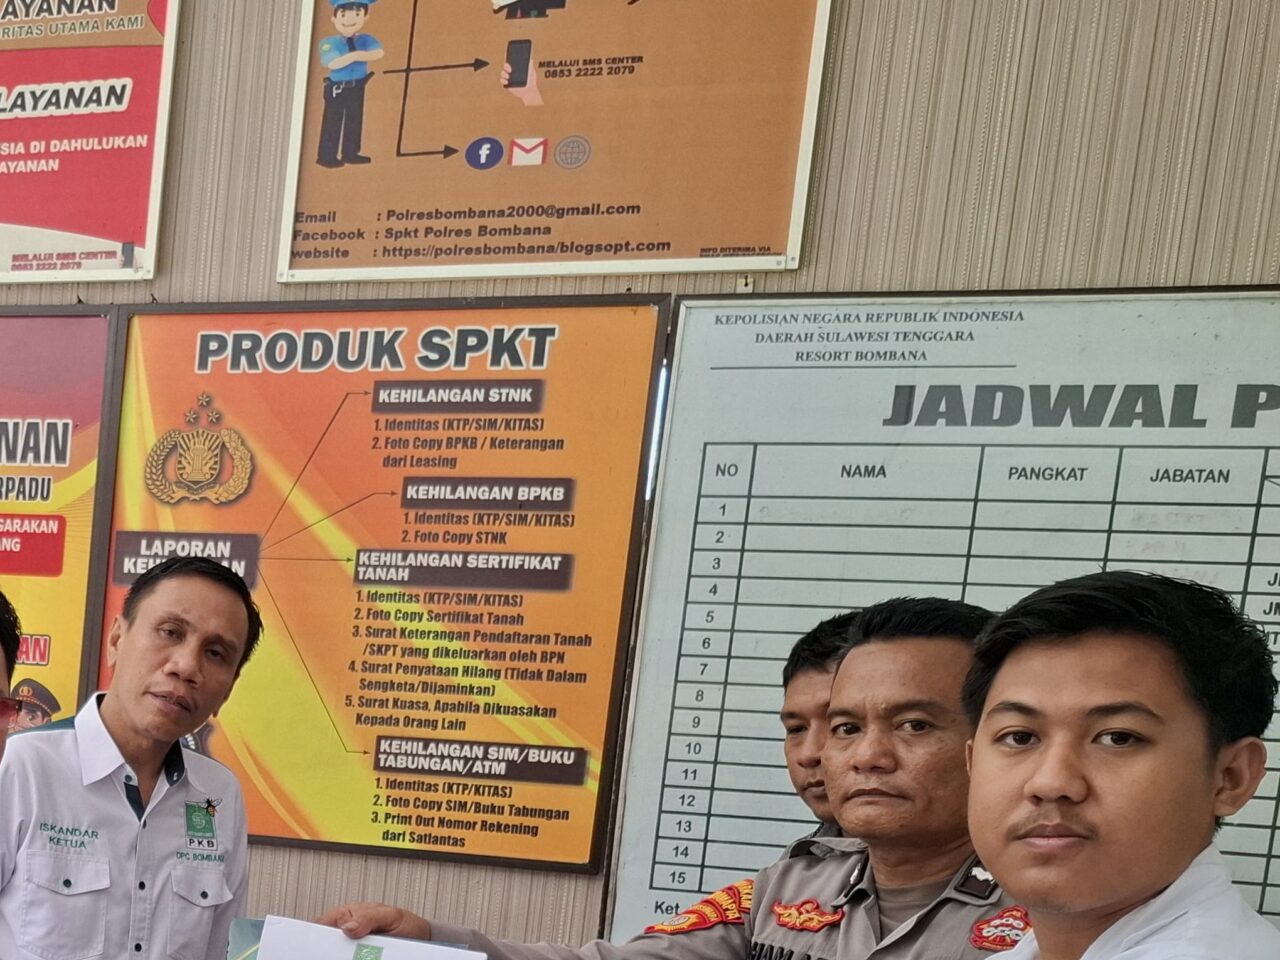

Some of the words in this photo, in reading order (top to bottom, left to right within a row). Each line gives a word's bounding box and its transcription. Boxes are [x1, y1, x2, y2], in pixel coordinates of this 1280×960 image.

[48, 21, 99, 38] UTAMA
[106, 15, 144, 31] KAMI
[539, 60, 580, 69] MELALUI
[584, 58, 603, 67] SMS
[607, 56, 643, 66] CENTER
[574, 67, 602, 78] 2222
[608, 66, 635, 76] 2079
[29, 139, 45, 153] DI
[50, 135, 147, 152] DAHULUKAN
[295, 211, 336, 223] Email
[386, 203, 640, 222] Polresbombana2000@gmail.com
[294, 228, 364, 242] Facebook
[385, 227, 419, 241] Spkt
[424, 226, 471, 238] Polres
[477, 223, 551, 238] Bombana
[293, 246, 348, 260] website
[715, 313, 798, 325] KEPOLISIAN
[801, 312, 861, 325] NEGARA
[865, 311, 938, 324] REPUBLIK
[942, 310, 1024, 323] INDONESIA
[755, 332, 814, 344] DAERAH
[818, 330, 890, 343] SULAWESI
[893, 329, 975, 343] TENGGARA
[197, 331, 404, 372] PRODUK
[416, 327, 555, 370] SPKT
[795, 350, 851, 363] RESORT
[855, 349, 927, 362] BOMBANA
[379, 387, 484, 404] KEHILANGAN
[487, 386, 532, 403] STNK
[883, 384, 1207, 428] JADWAL
[385, 436, 410, 450] Foto
[414, 436, 442, 452] Copy
[445, 436, 477, 450] BPKB
[491, 437, 564, 452] Keterangan
[383, 455, 406, 468] dari
[409, 455, 457, 469] Leasing
[716, 463, 738, 478] NO
[841, 463, 887, 479] NAMA
[1008, 467, 1088, 481] PANGKAT
[1150, 469, 1230, 484] JABATAN
[407, 485, 511, 501] KEHILANGAN
[517, 485, 564, 501] BPKB
[718, 505, 728, 516] 1
[414, 530, 440, 544] Foto
[443, 530, 472, 546] Copy
[475, 531, 507, 545] STNK
[715, 531, 724, 543] 2
[140, 540, 230, 557] LAPORAN
[358, 552, 462, 568] KEHILANGAN
[467, 555, 560, 571] SERTIFIKAT
[712, 558, 721, 570] 3
[357, 566, 408, 581] TANAH
[708, 584, 718, 596] 4
[705, 610, 714, 623] 5
[701, 637, 711, 649] 6
[699, 664, 708, 675] 7
[695, 690, 704, 701] 8
[691, 717, 701, 728] 9
[380, 740, 483, 759] KEHILANGAN
[487, 746, 574, 764] SIM/BUKU
[685, 742, 701, 754] 10
[379, 754, 506, 776] TABUNGAN/ATM
[681, 768, 698, 781] 11
[678, 794, 696, 807] 12
[40, 823, 99, 840] ISKANDAR
[675, 820, 692, 833] 13
[49, 837, 86, 849] KETUA
[189, 839, 215, 848] PKB
[672, 846, 689, 859] 14
[669, 871, 686, 884] 15
